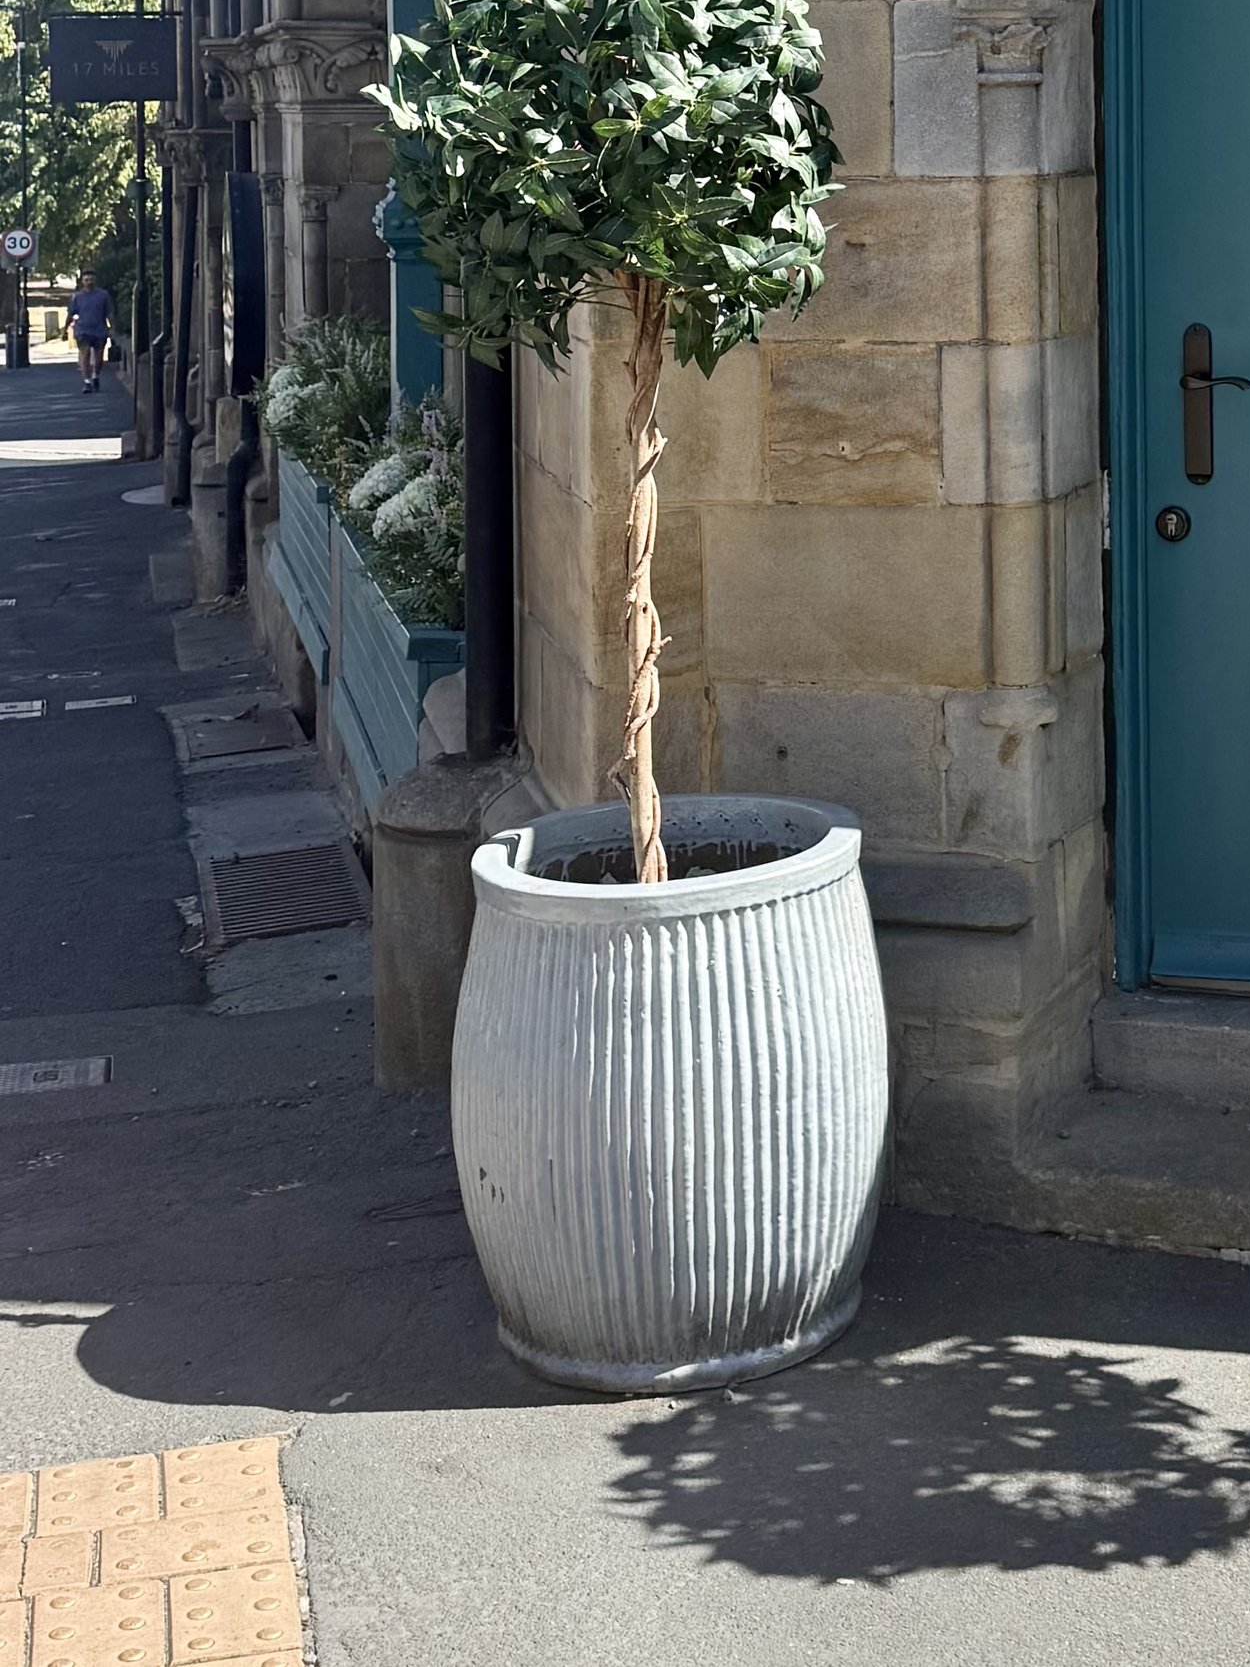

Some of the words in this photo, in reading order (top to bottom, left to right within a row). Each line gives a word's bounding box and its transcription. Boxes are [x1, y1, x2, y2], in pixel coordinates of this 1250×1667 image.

[73, 62, 93, 76] 17
[103, 61, 160, 76] MILES
[7, 236, 30, 250] 30
